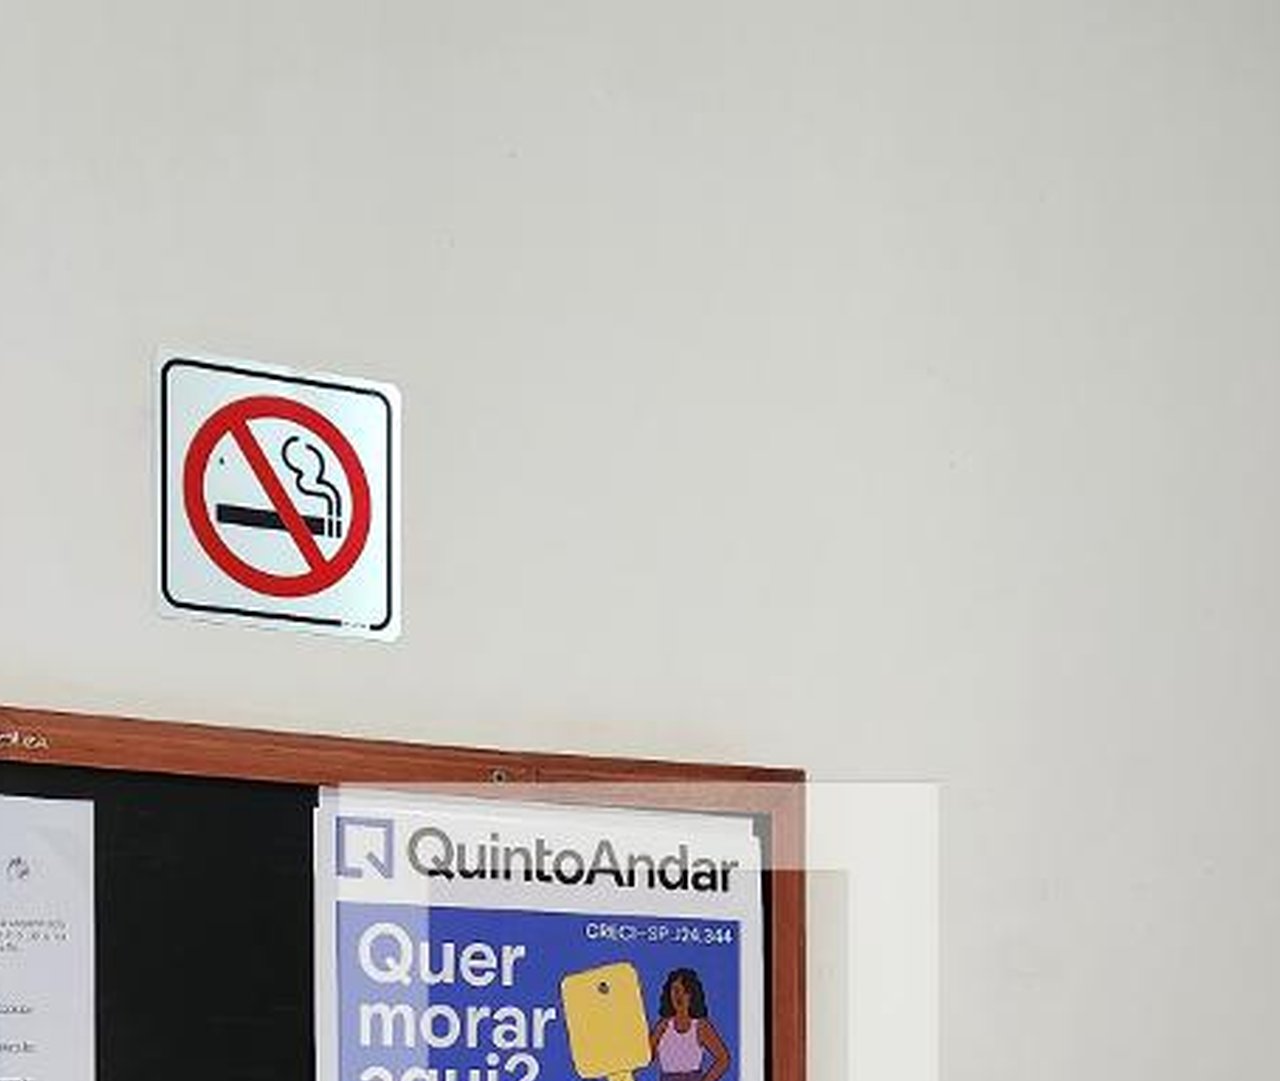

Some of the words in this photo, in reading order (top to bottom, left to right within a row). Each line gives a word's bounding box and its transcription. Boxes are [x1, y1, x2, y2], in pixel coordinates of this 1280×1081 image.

[407, 826, 739, 893] QuintoAndar
[357, 921, 526, 986] Quer
[359, 1002, 556, 1050] morar
